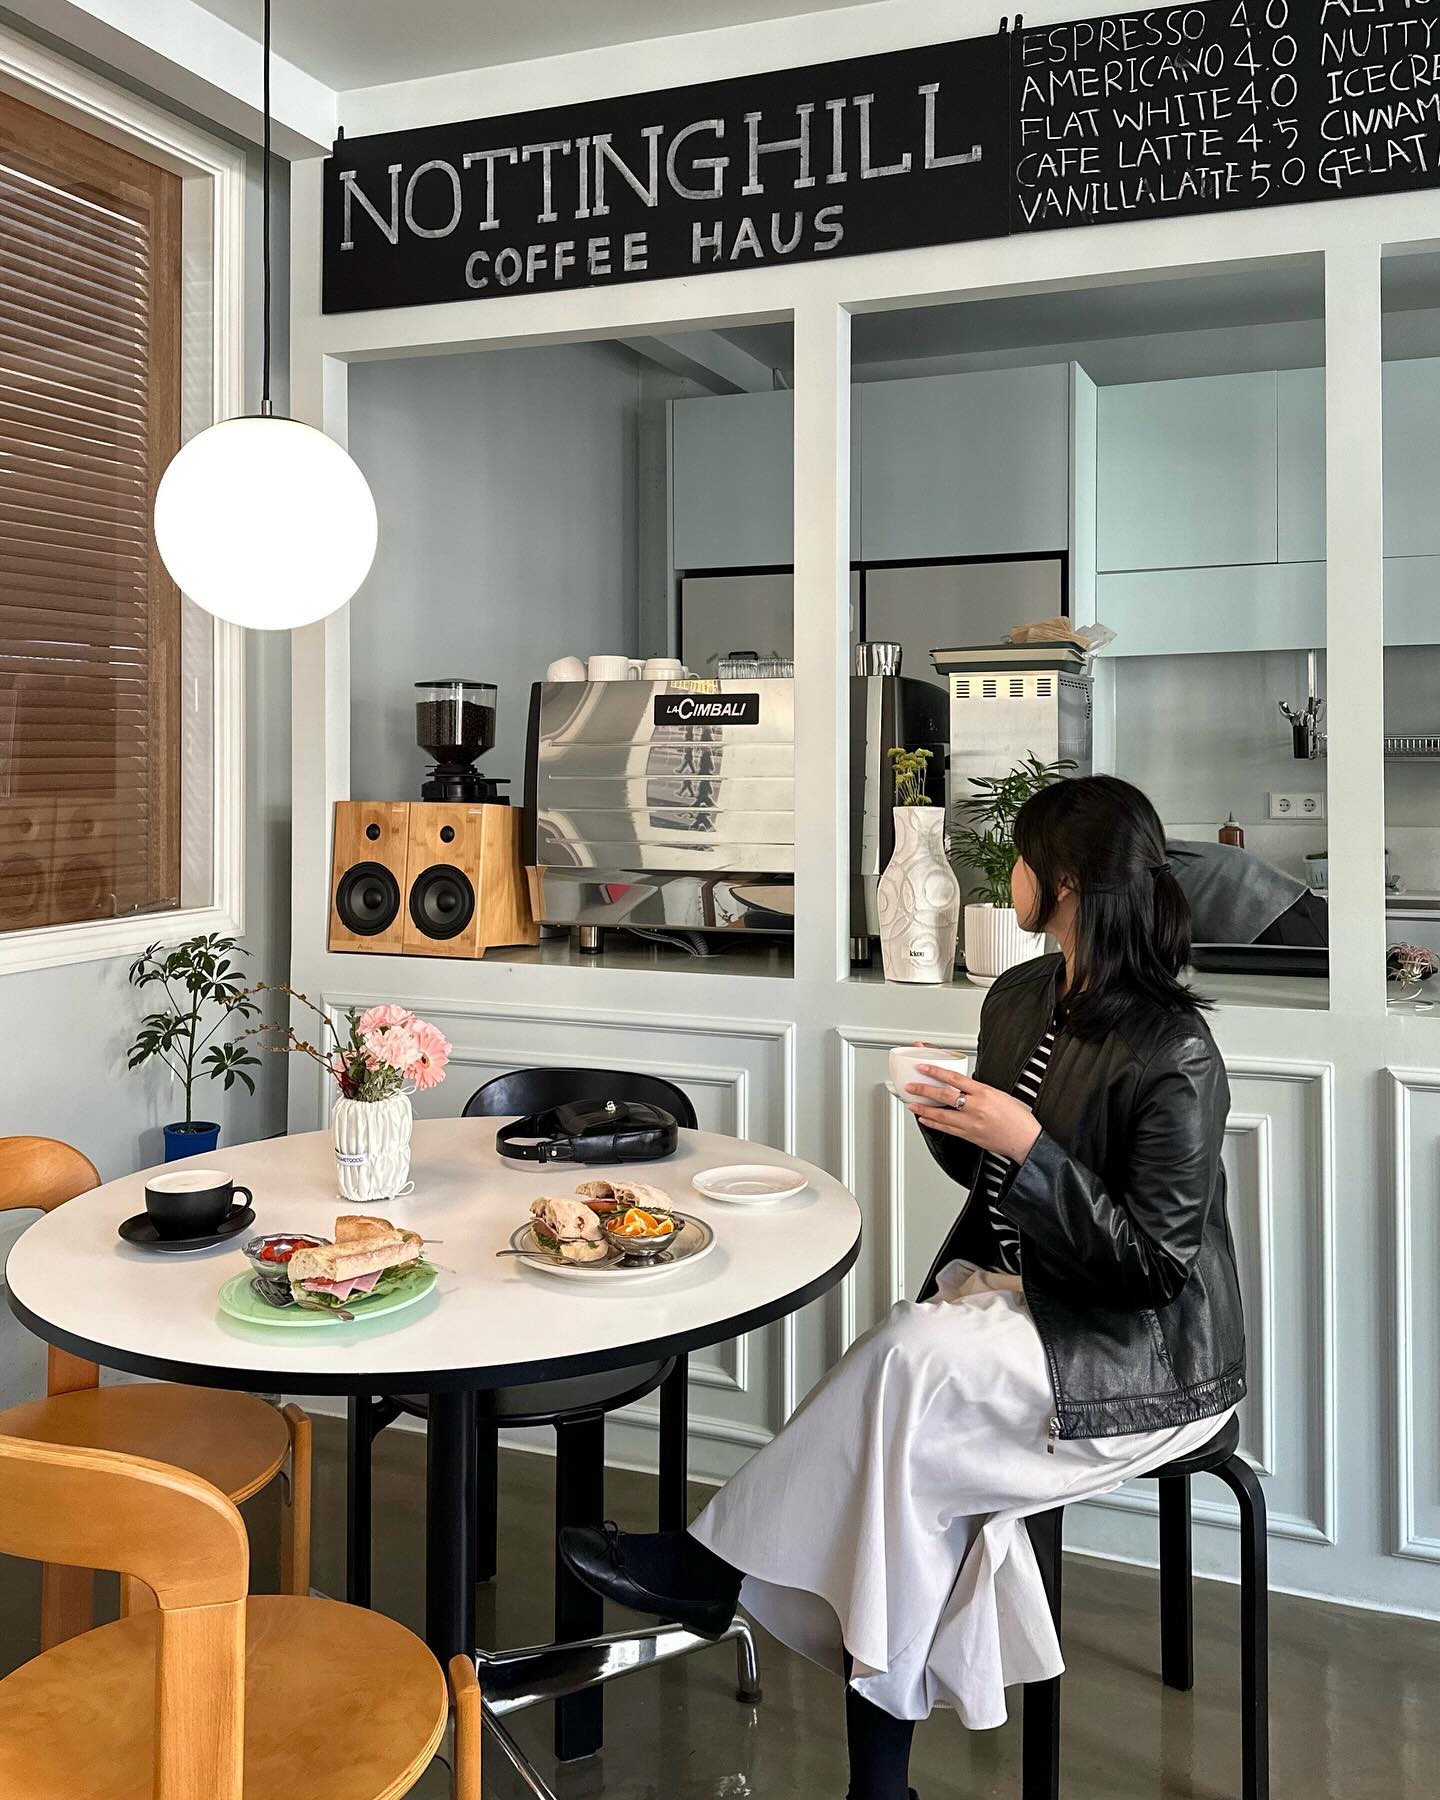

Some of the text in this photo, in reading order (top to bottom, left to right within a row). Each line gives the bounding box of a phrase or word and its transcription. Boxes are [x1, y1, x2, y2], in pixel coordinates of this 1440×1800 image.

[1022, 10, 1206, 67] ESPRESSO
[1321, 17, 1438, 66] NUTTY
[1020, 35, 1298, 112] AMERICANO 4.0
[1020, 74, 1298, 146] FLAT WHITE 4.0
[1016, 118, 1298, 187] CAFE LATTE 4.5
[1319, 133, 1440, 189] GELAT
[465, 205, 844, 288] COFFEE HAUS
